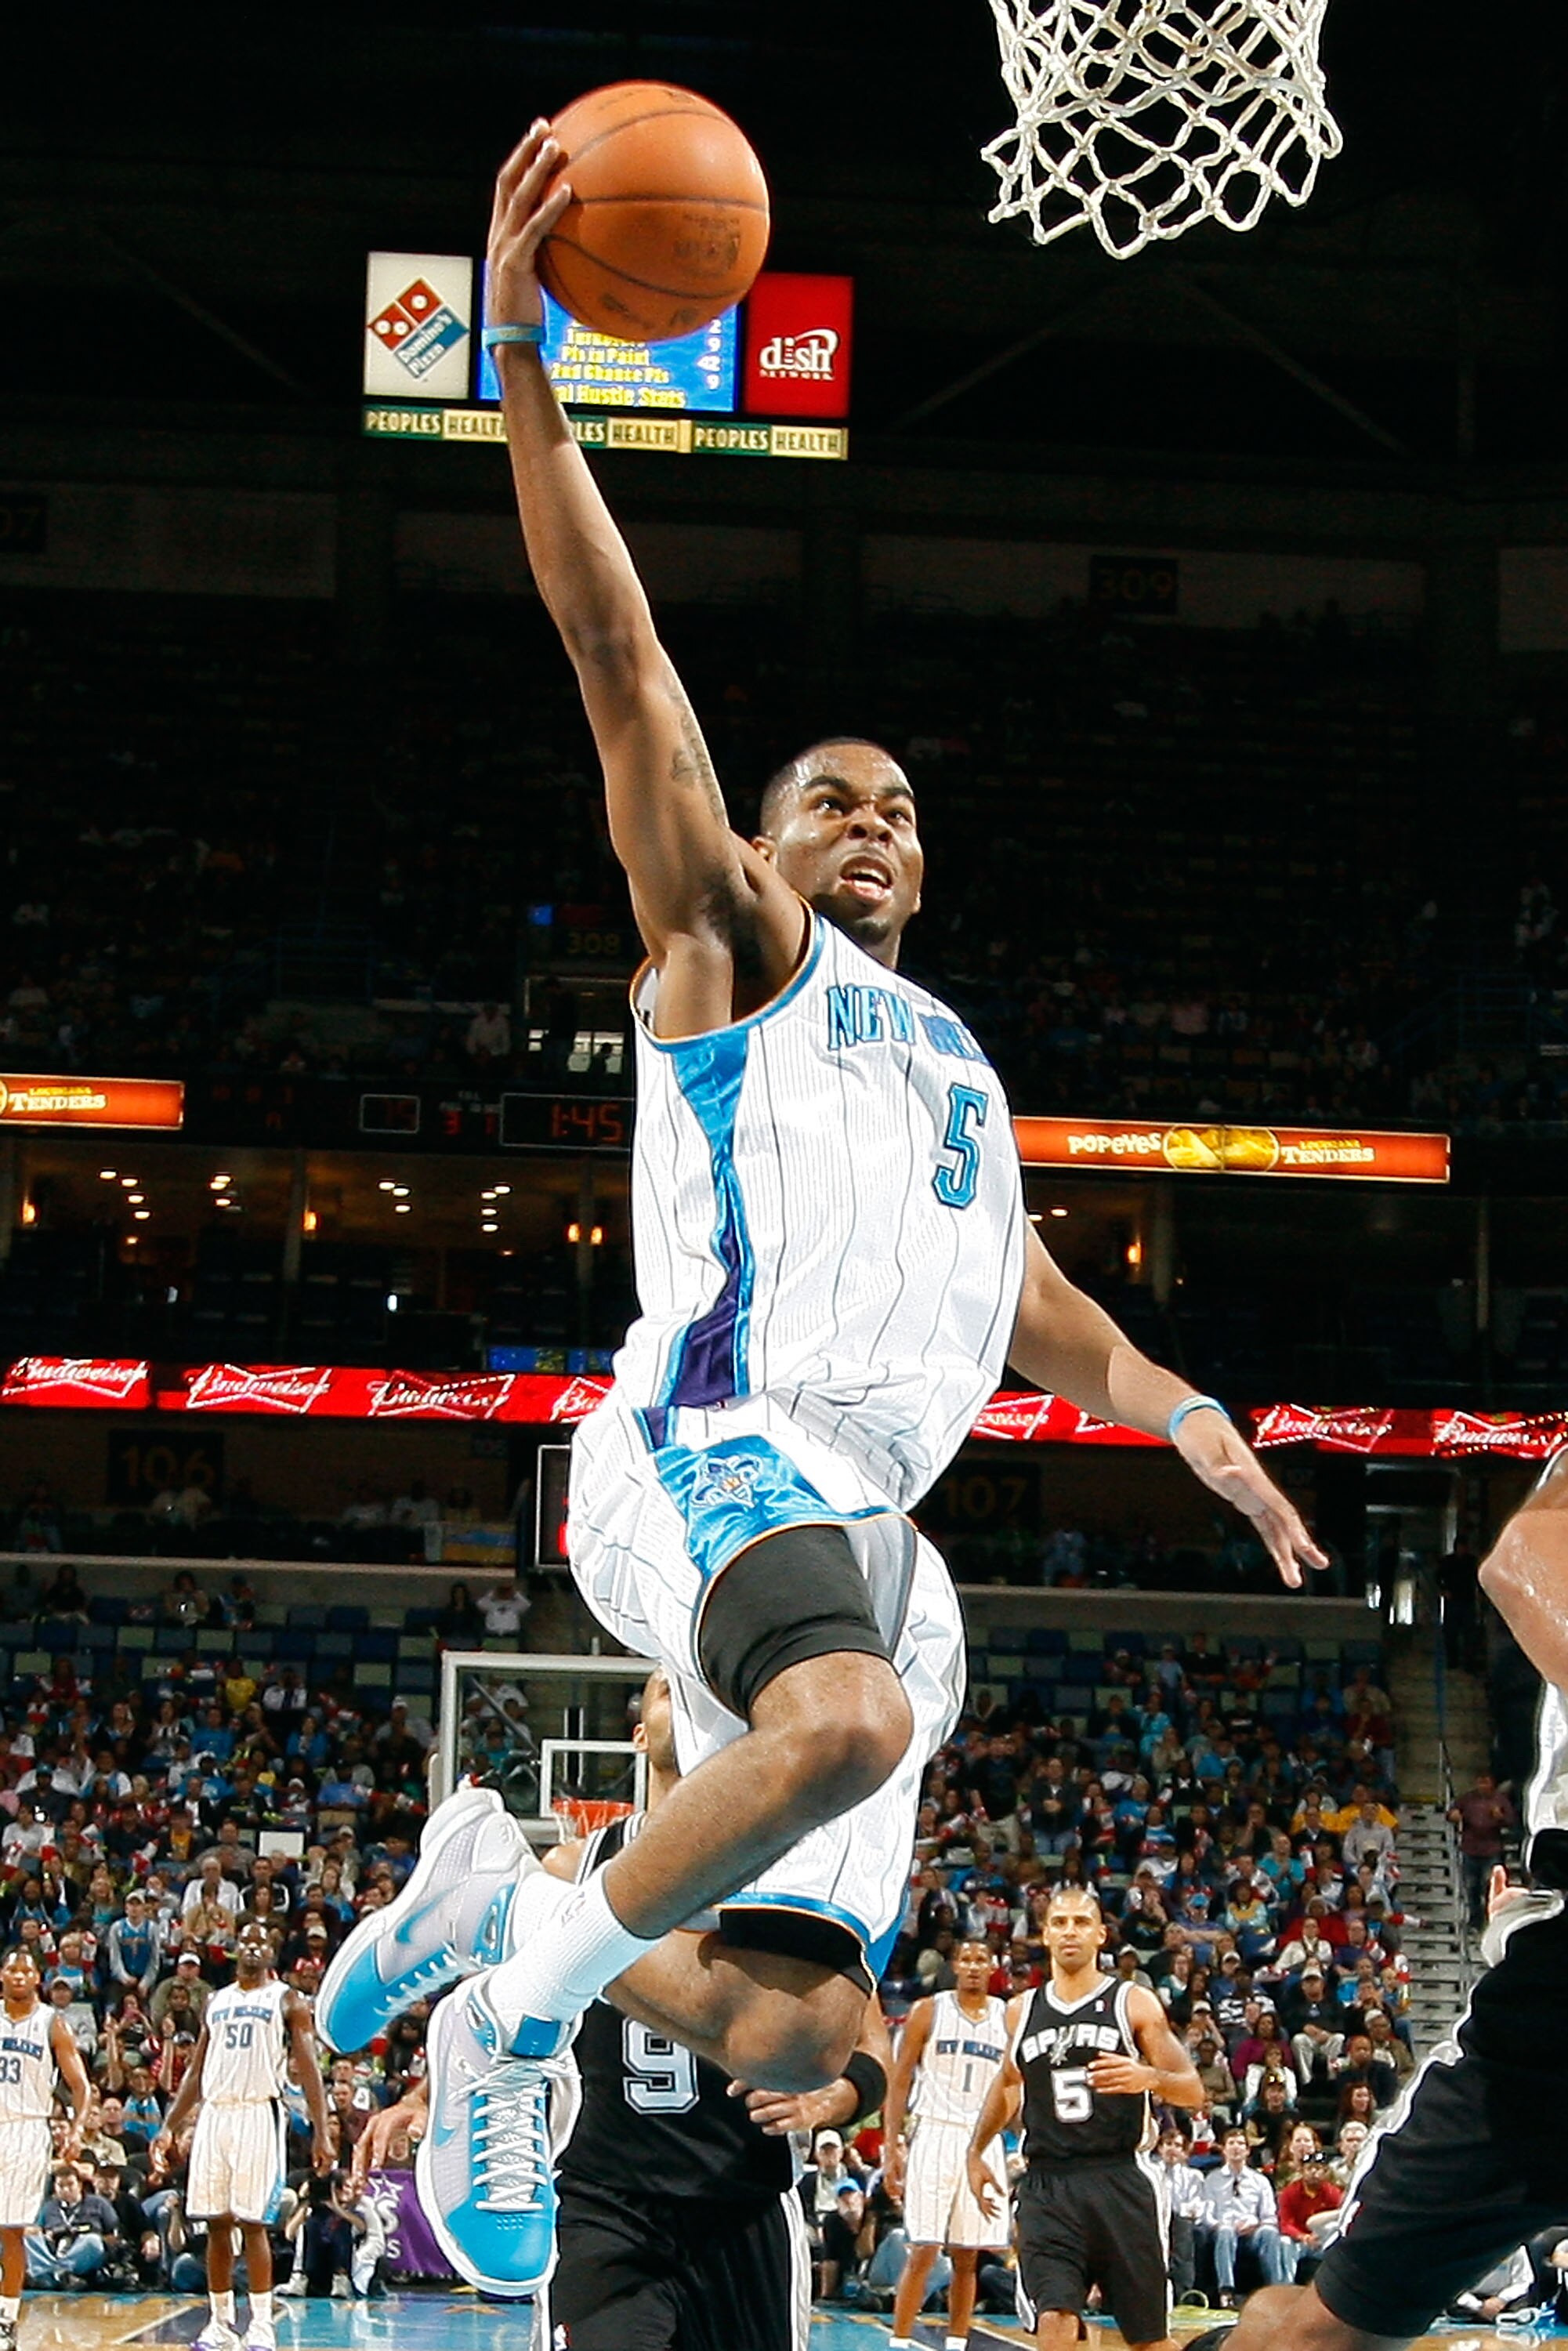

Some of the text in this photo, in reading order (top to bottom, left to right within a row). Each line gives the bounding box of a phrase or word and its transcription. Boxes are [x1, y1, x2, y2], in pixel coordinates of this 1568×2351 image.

[397, 313, 454, 364] Domino's
[708, 336, 721, 352] 9
[760, 328, 838, 371] dish
[407, 342, 445, 376] Pizza
[583, 364, 642, 382] Chance
[707, 373, 720, 390] 9
[576, 383, 635, 406] Hustle
[637, 386, 685, 408] Stats
[365, 411, 441, 433] PEOPLES
[613, 424, 675, 444] HEALTH
[695, 426, 768, 450] PEOPLES
[777, 430, 838, 451] HEALTH
[826, 983, 917, 1051] NEW
[8, 1093, 107, 1112] TENDERS
[551, 1101, 625, 1144] 1:45
[932, 1081, 989, 1210] 5
[1281, 1146, 1374, 1165] TENDERS
[19, 1357, 148, 1382] Budweiser
[197, 1370, 330, 1396] Budweiser
[121, 1444, 217, 1490] 106
[943, 1475, 1029, 1518] 107
[225, 2023, 253, 2049] 50
[1021, 2023, 1121, 2063] SPURS
[622, 2014, 700, 2114] 9
[962, 2063, 972, 2092] 1
[1051, 2067, 1094, 2123] 5
